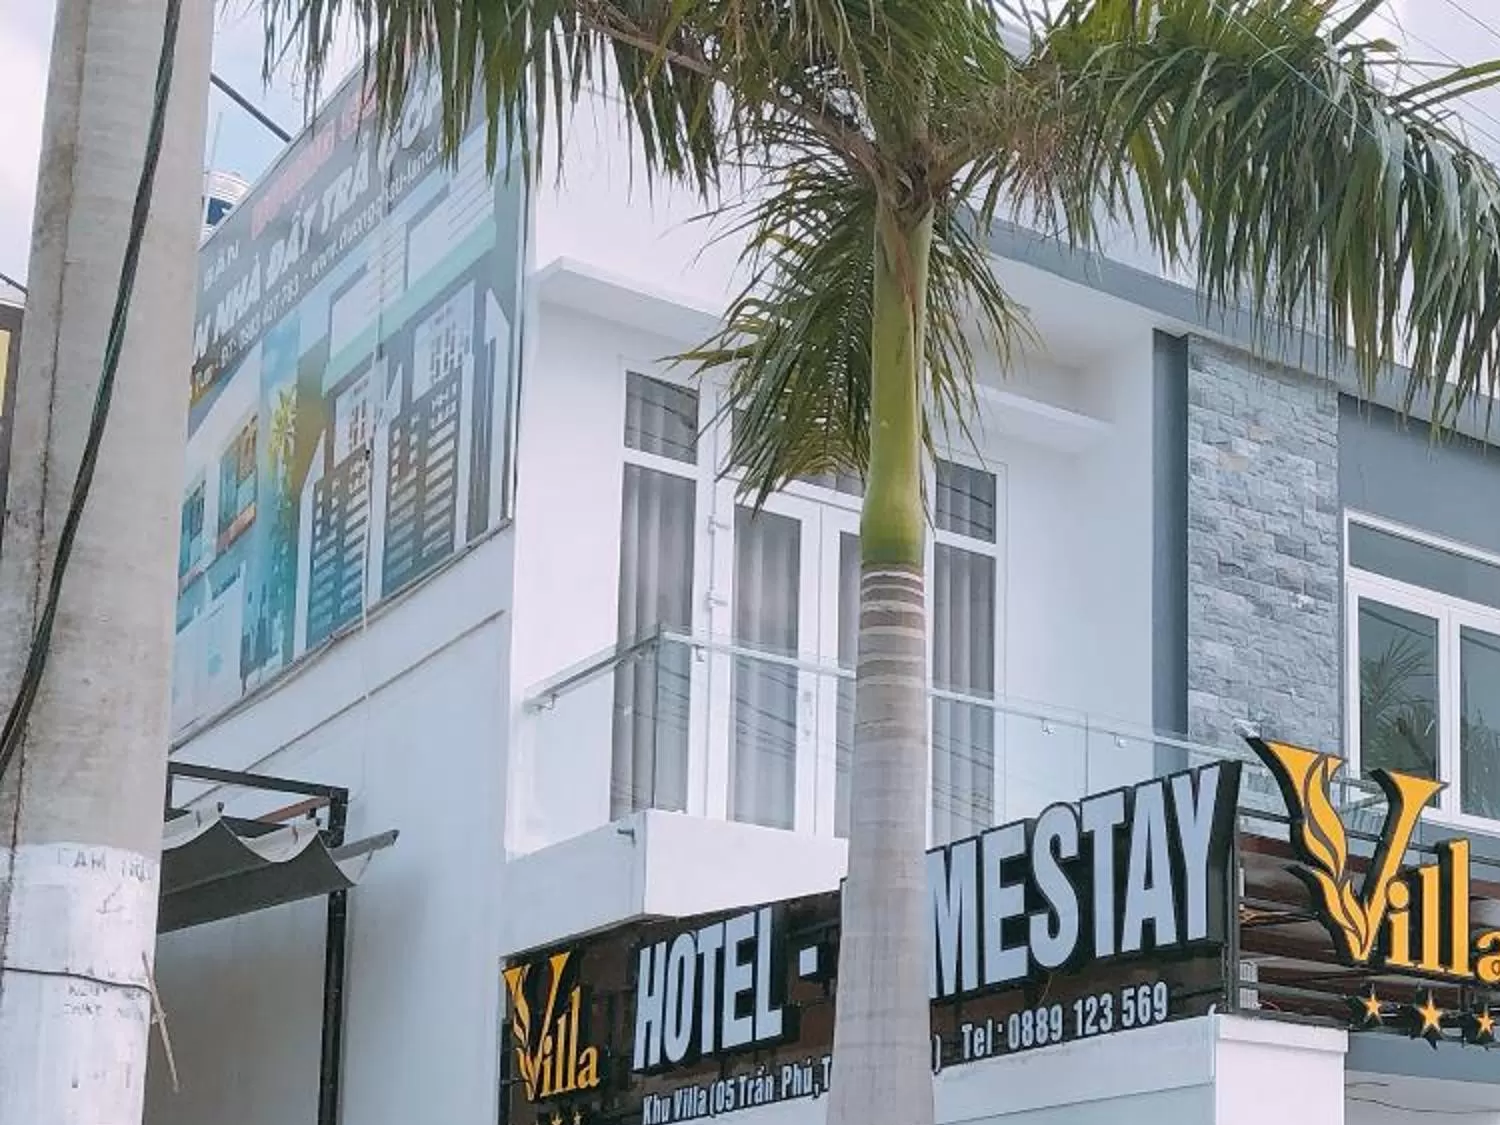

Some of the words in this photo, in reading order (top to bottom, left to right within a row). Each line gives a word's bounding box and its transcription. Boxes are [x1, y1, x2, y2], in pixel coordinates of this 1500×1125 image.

[633, 907, 783, 1073] HOTEL
[926, 762, 1221, 1001] MESTAY
[501, 950, 601, 1102] Villa
[673, 1084, 707, 1121] Villa
[1007, 1003, 1063, 1050] 0889
[1072, 992, 1113, 1037] 123
[1121, 980, 1168, 1028] 569
